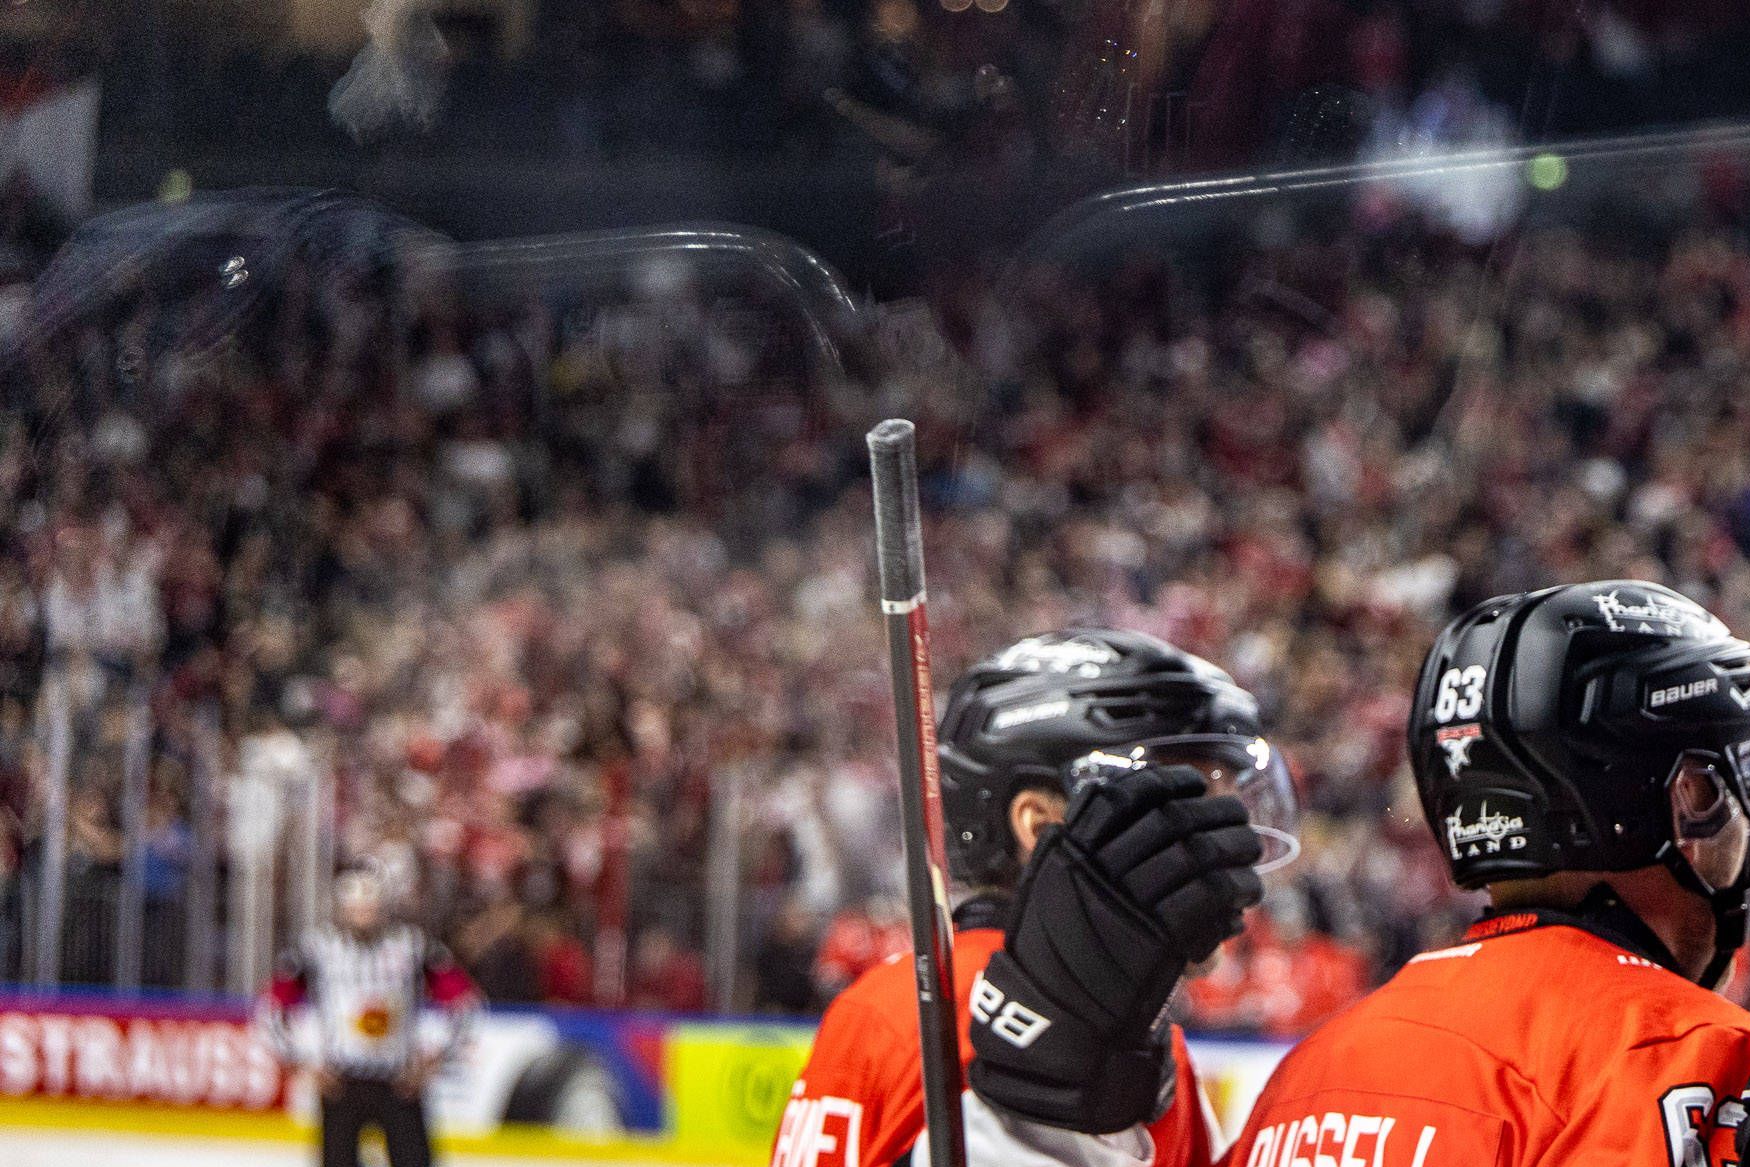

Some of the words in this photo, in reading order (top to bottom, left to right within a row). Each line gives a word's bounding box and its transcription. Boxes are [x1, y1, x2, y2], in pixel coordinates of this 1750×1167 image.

[1435, 665, 1487, 723] 63
[1651, 678, 1719, 708] BAUER
[969, 970, 1052, 1048] BA
[0, 1012, 281, 1111] STRAUSS
